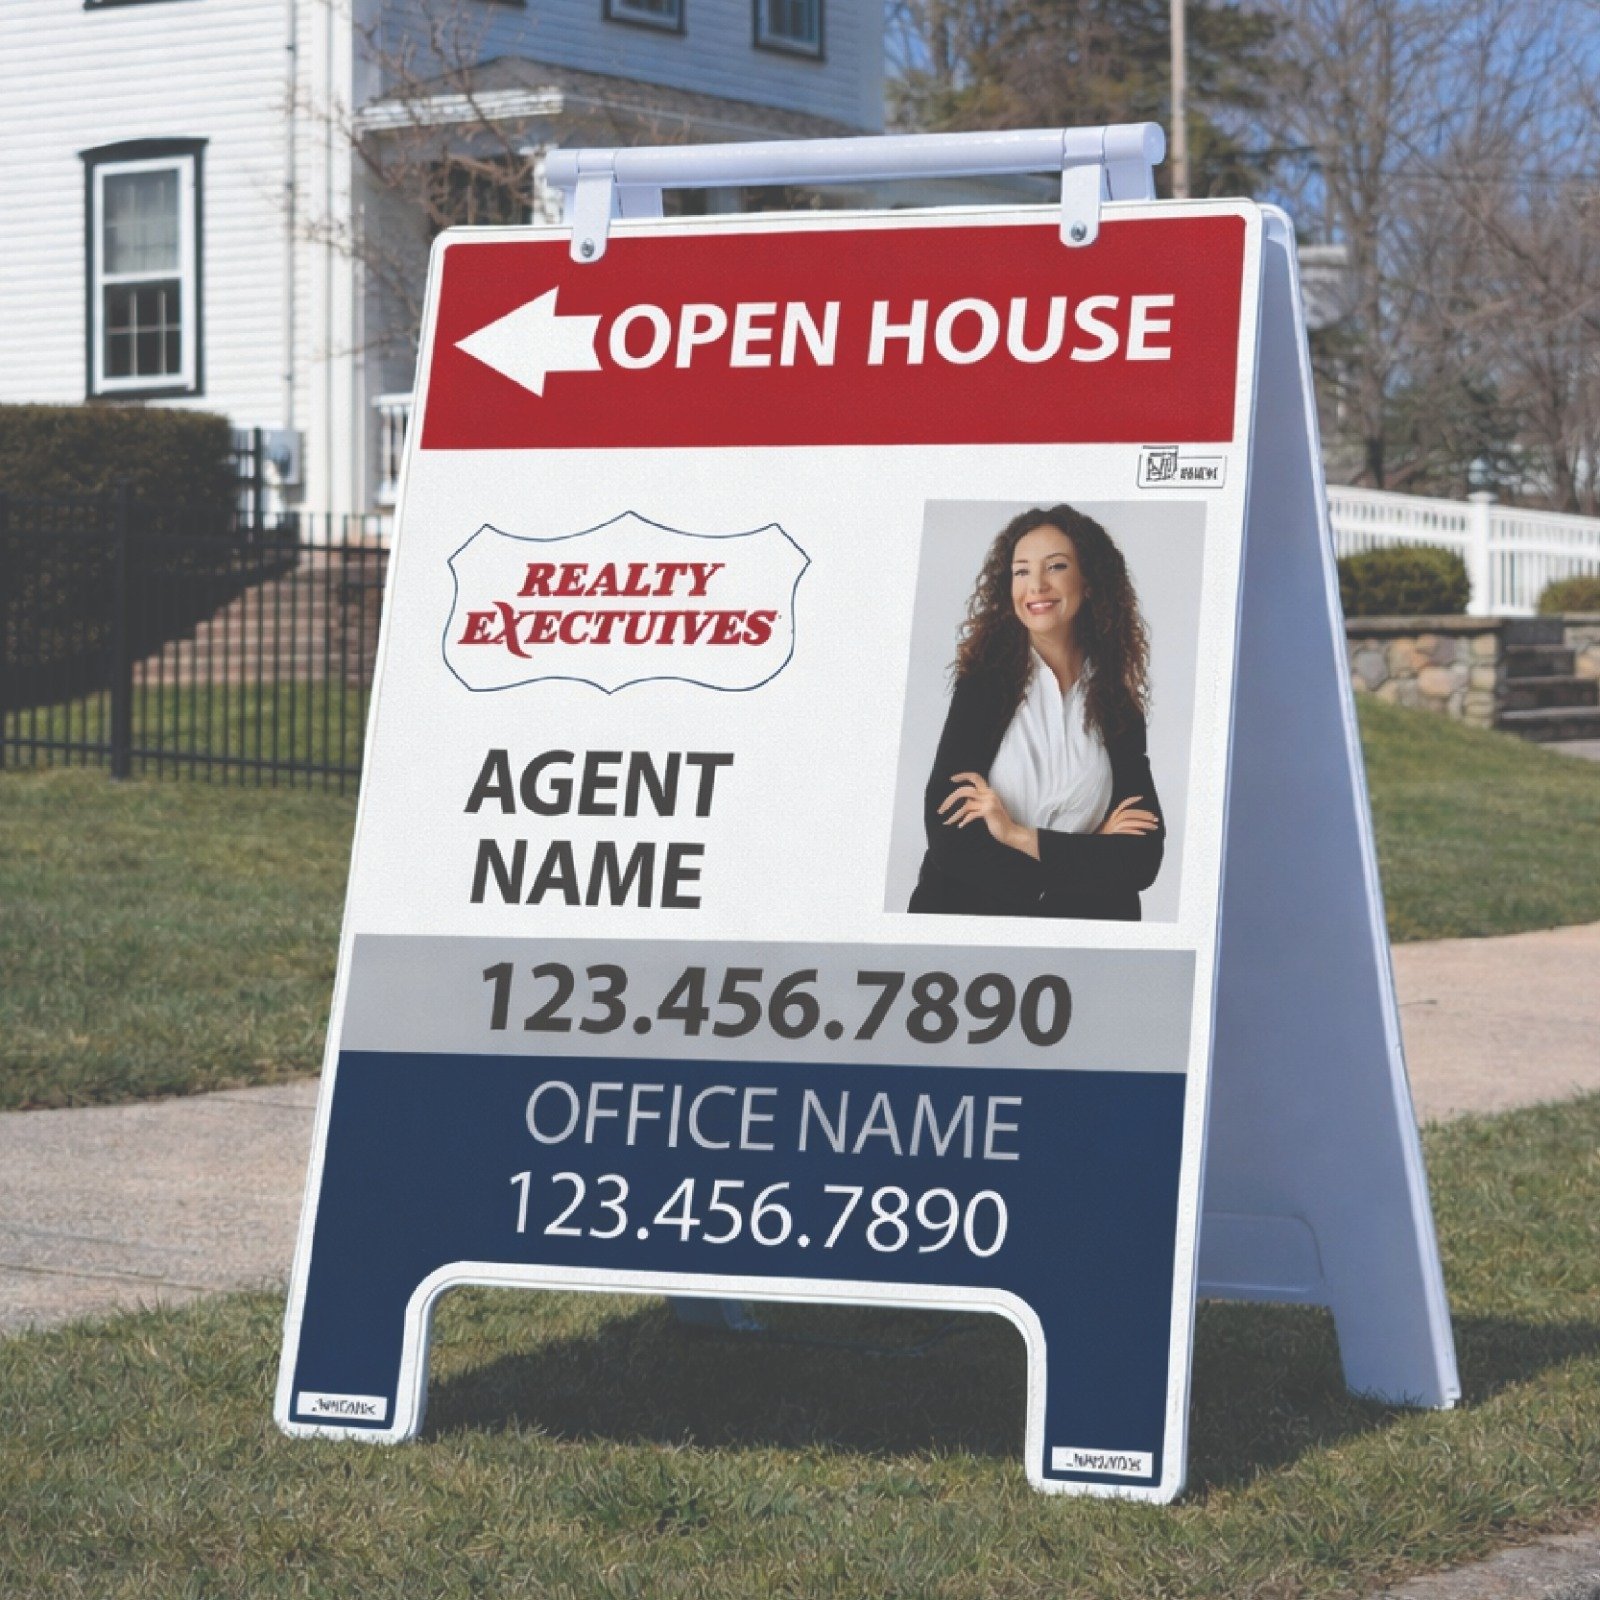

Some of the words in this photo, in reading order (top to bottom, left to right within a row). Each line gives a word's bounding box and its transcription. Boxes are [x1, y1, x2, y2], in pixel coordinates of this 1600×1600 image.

[608, 301, 841, 369] OPEN
[867, 294, 1176, 365] HOUSE
[517, 562, 726, 597] REALTY
[458, 601, 778, 659] EXECTUIVES
[464, 749, 734, 818] AGENT
[470, 838, 705, 910] NAME
[482, 962, 1073, 1047] 123.456.7890
[525, 1080, 778, 1152] OFFICE
[798, 1090, 1023, 1161] NAME
[509, 1170, 1008, 1258] 123.456.7890
